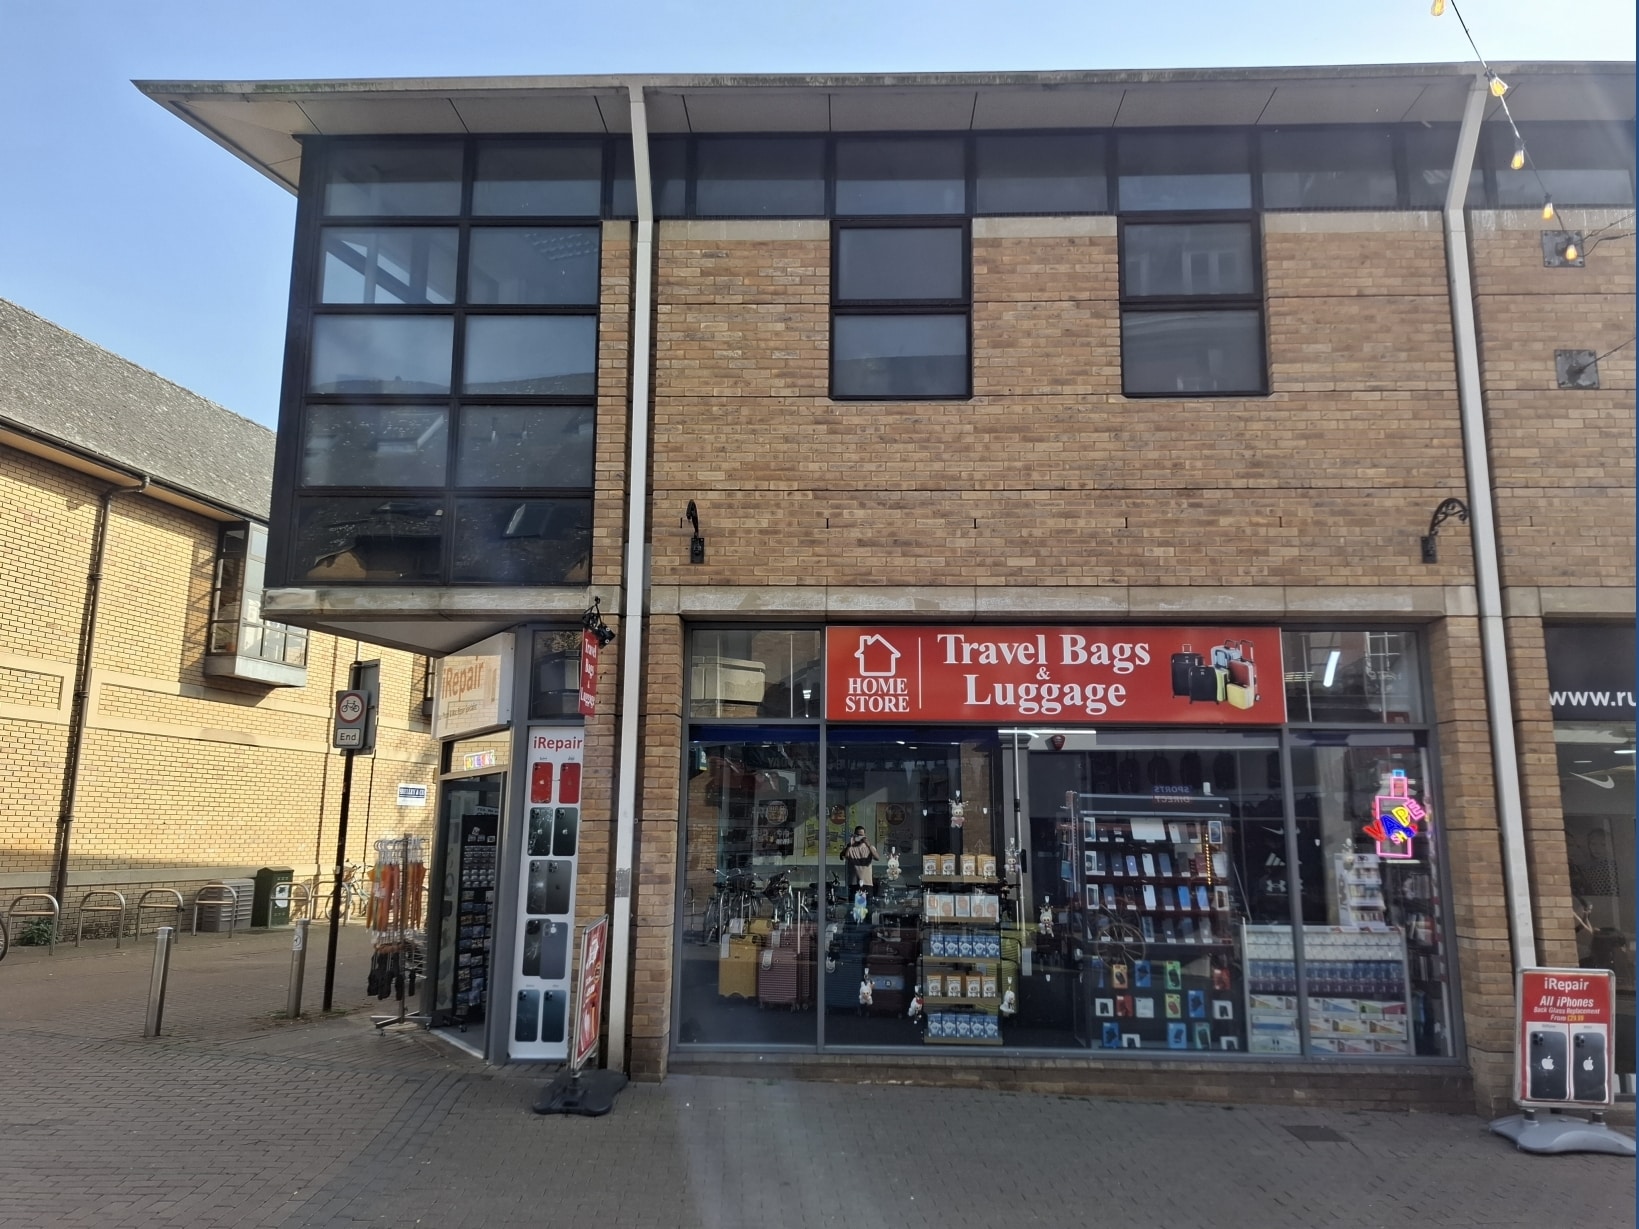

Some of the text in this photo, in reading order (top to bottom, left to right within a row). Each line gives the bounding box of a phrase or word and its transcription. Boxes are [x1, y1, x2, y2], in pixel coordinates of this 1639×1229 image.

[937, 633, 1151, 674] Travel Bags
[441, 656, 484, 702] iRepair
[1035, 666, 1051, 680] &
[847, 677, 908, 695] HOME
[963, 674, 1127, 714] Luggage
[845, 696, 910, 713] STORE
[340, 732, 356, 741] End
[533, 736, 583, 752] iRepair
[1363, 799, 1426, 842] VAPE
[1544, 977, 1589, 993] iRepair
[1540, 995, 1594, 1007] All iPhones
